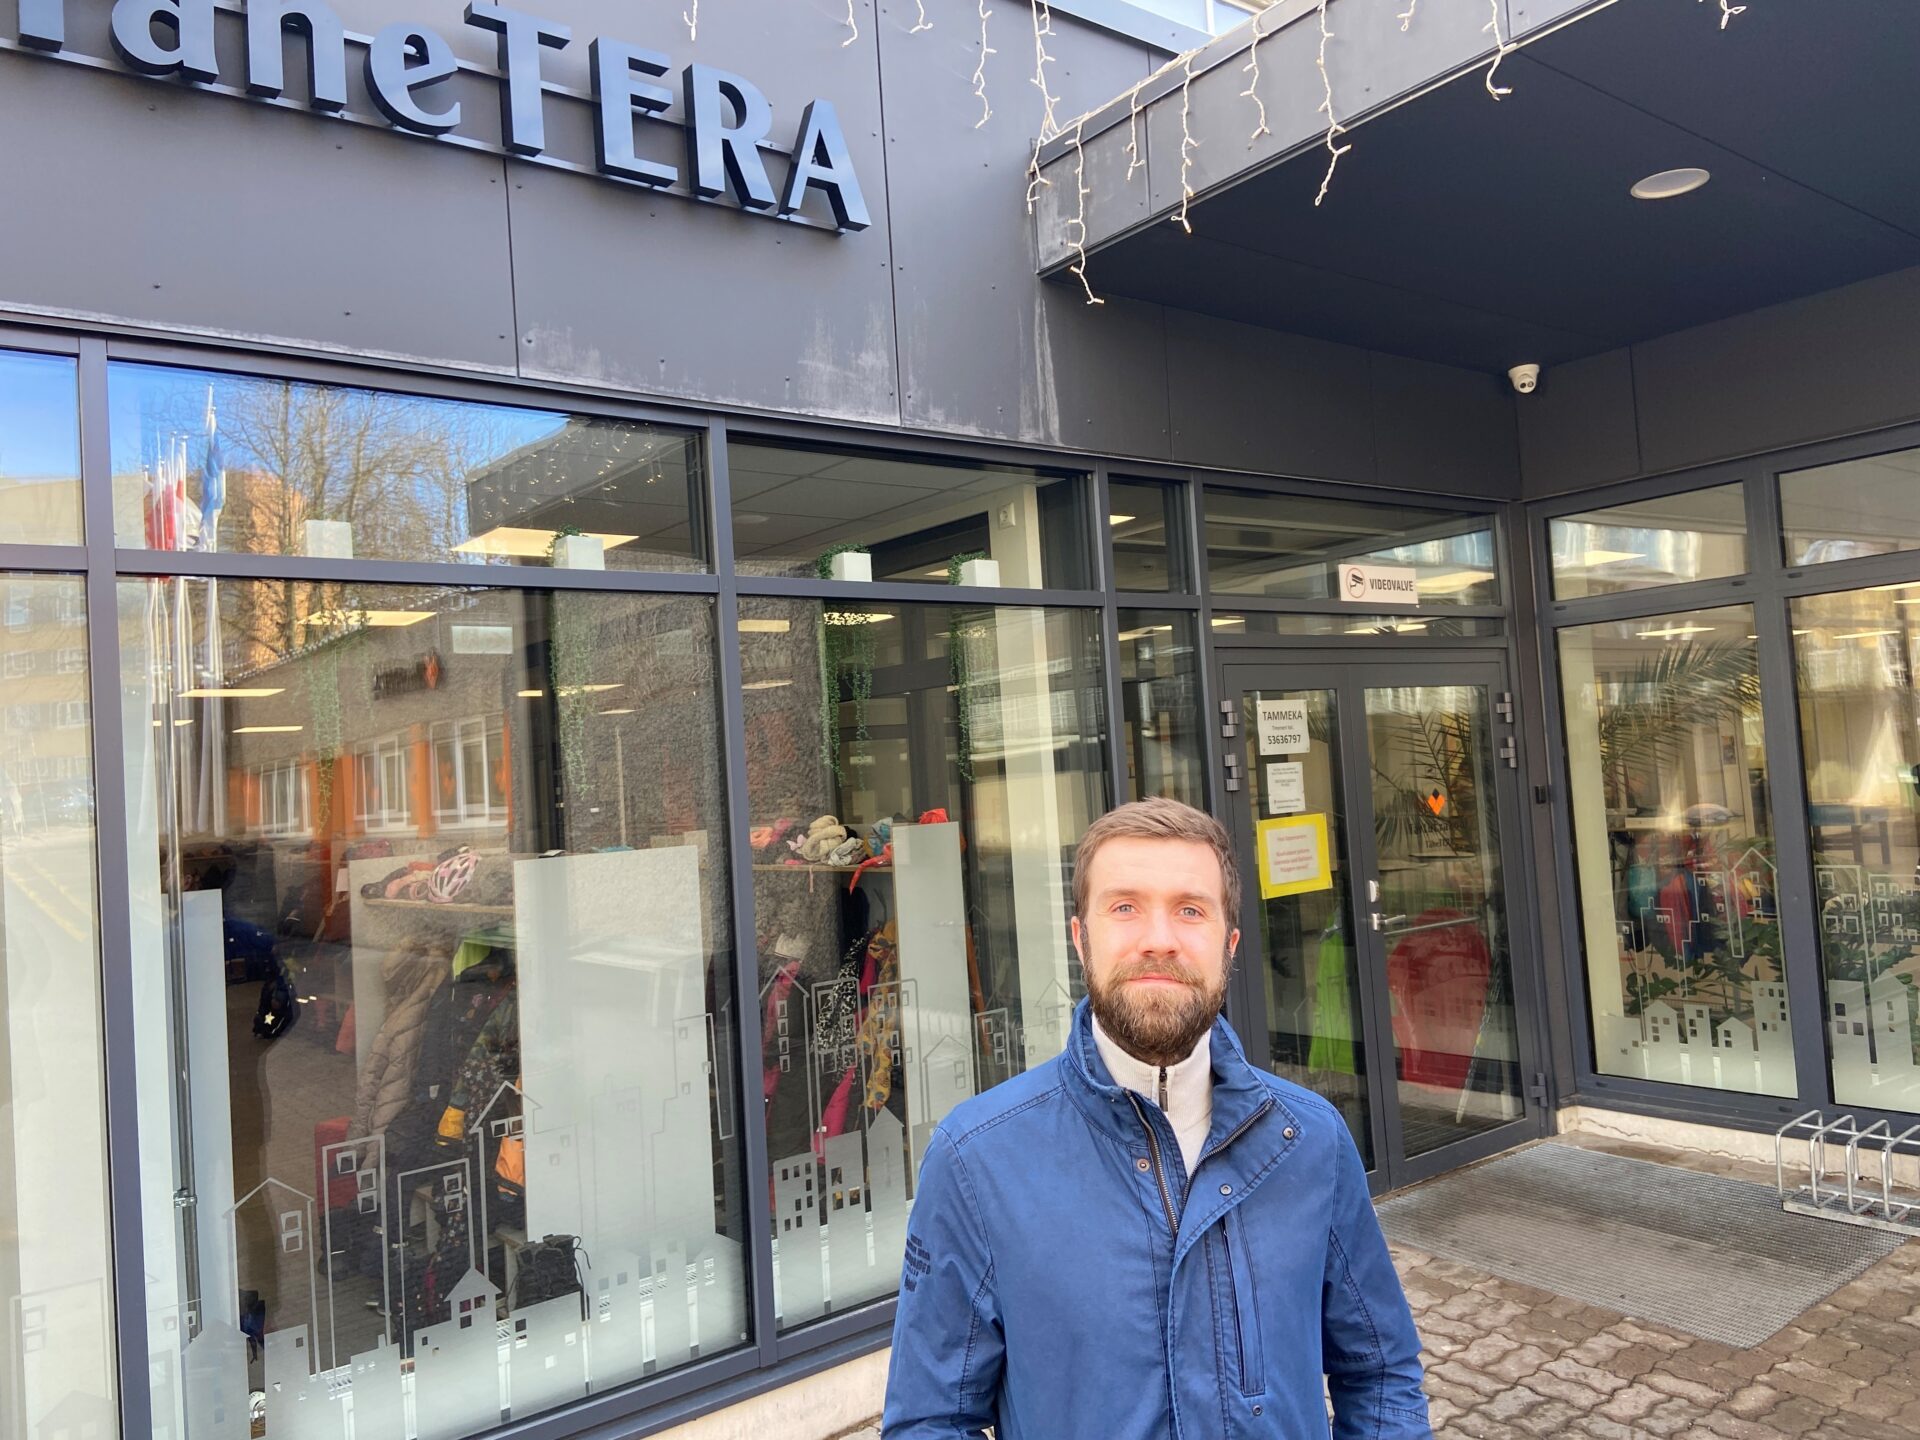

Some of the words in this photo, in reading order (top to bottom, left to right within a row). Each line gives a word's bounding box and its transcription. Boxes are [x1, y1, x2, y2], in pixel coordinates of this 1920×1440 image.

[1369, 578, 1414, 592] VIDEOVALVE
[1262, 710, 1303, 721] TAMMEKA
[1267, 734, 1301, 745] 53636797
